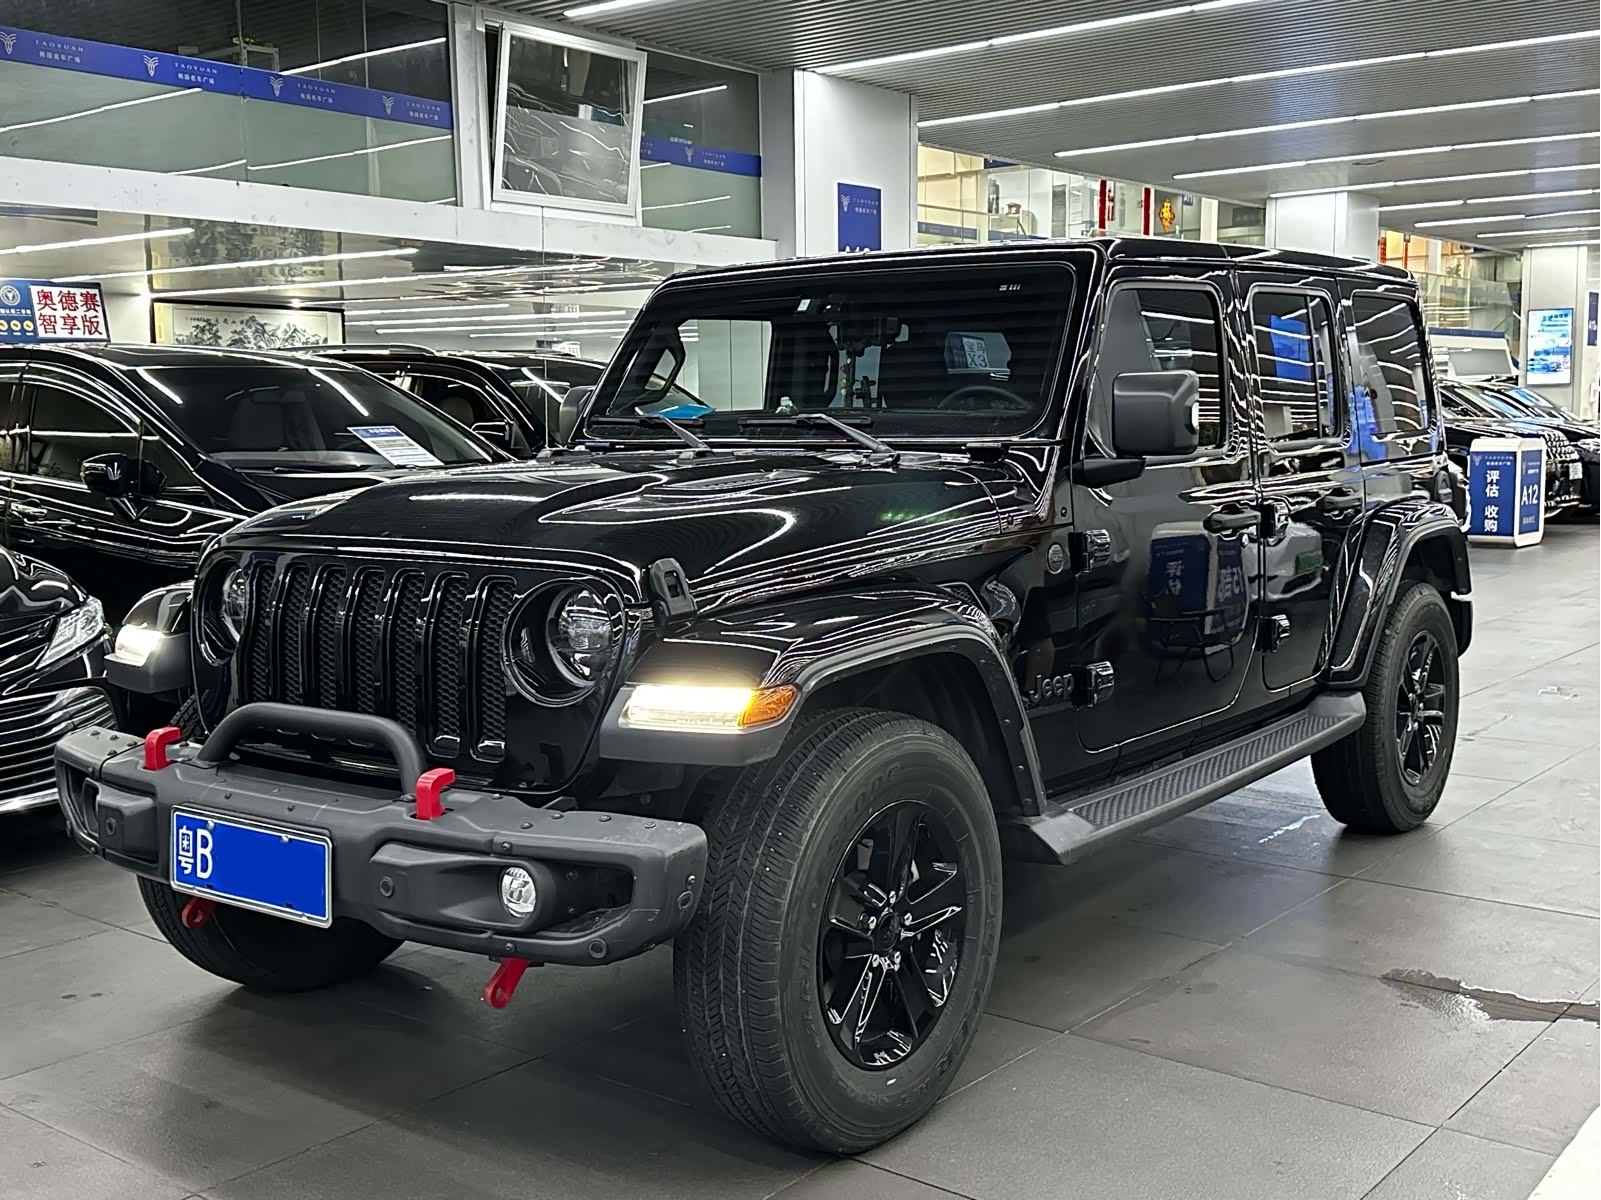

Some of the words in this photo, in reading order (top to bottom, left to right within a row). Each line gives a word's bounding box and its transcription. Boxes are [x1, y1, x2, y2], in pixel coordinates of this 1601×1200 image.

[35, 39, 84, 52] TAOYUAN
[174, 62, 217, 74] TAOYUAN
[36, 289, 100, 313] 奥德赛
[38, 312, 103, 336] 智享版
[967, 352, 988, 368] X3
[1485, 470, 1500, 498] 评估
[1521, 484, 1538, 505] A12
[1484, 505, 1499, 532] 收购
[1029, 673, 1075, 702] Jeep
[178, 825, 213, 879] 粤B
